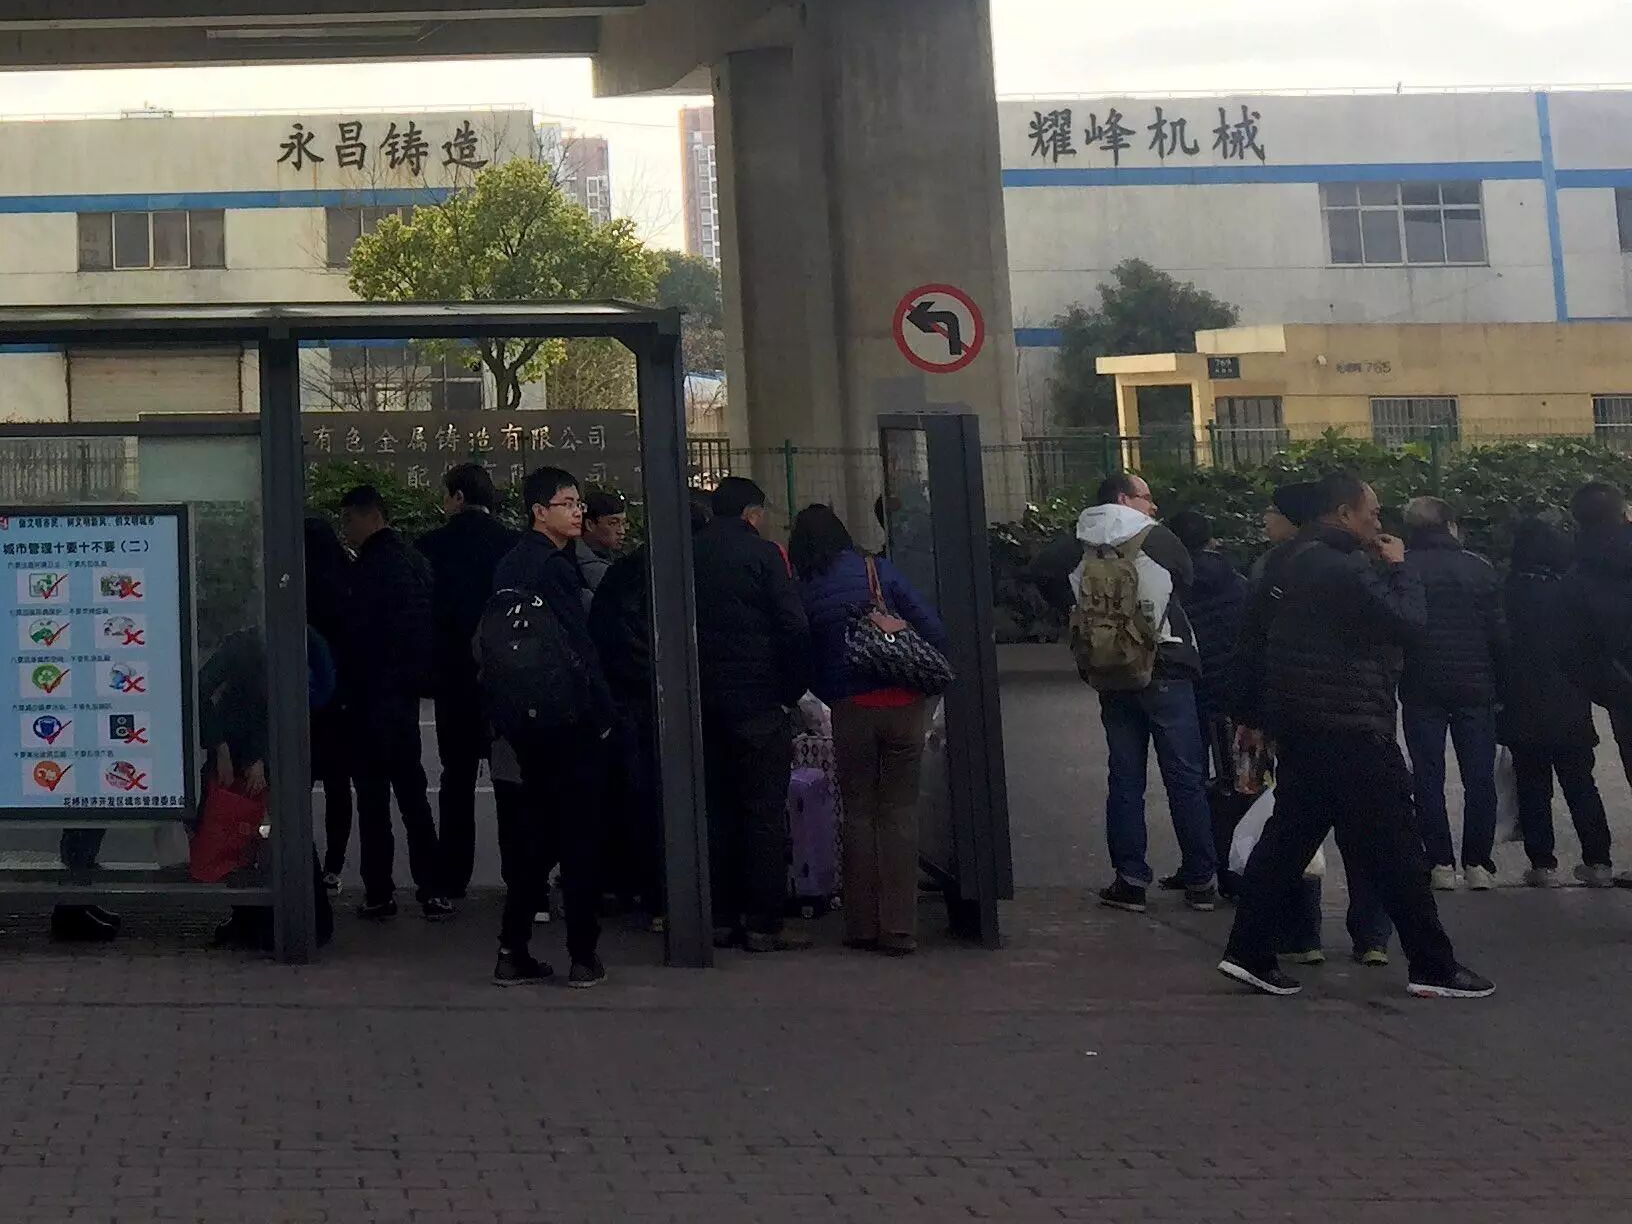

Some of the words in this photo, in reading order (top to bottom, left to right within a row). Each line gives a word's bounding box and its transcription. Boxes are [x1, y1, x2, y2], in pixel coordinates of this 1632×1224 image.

[276, 120, 489, 176] 永昌铸造
[1027, 104, 1267, 167] 耀峰机械
